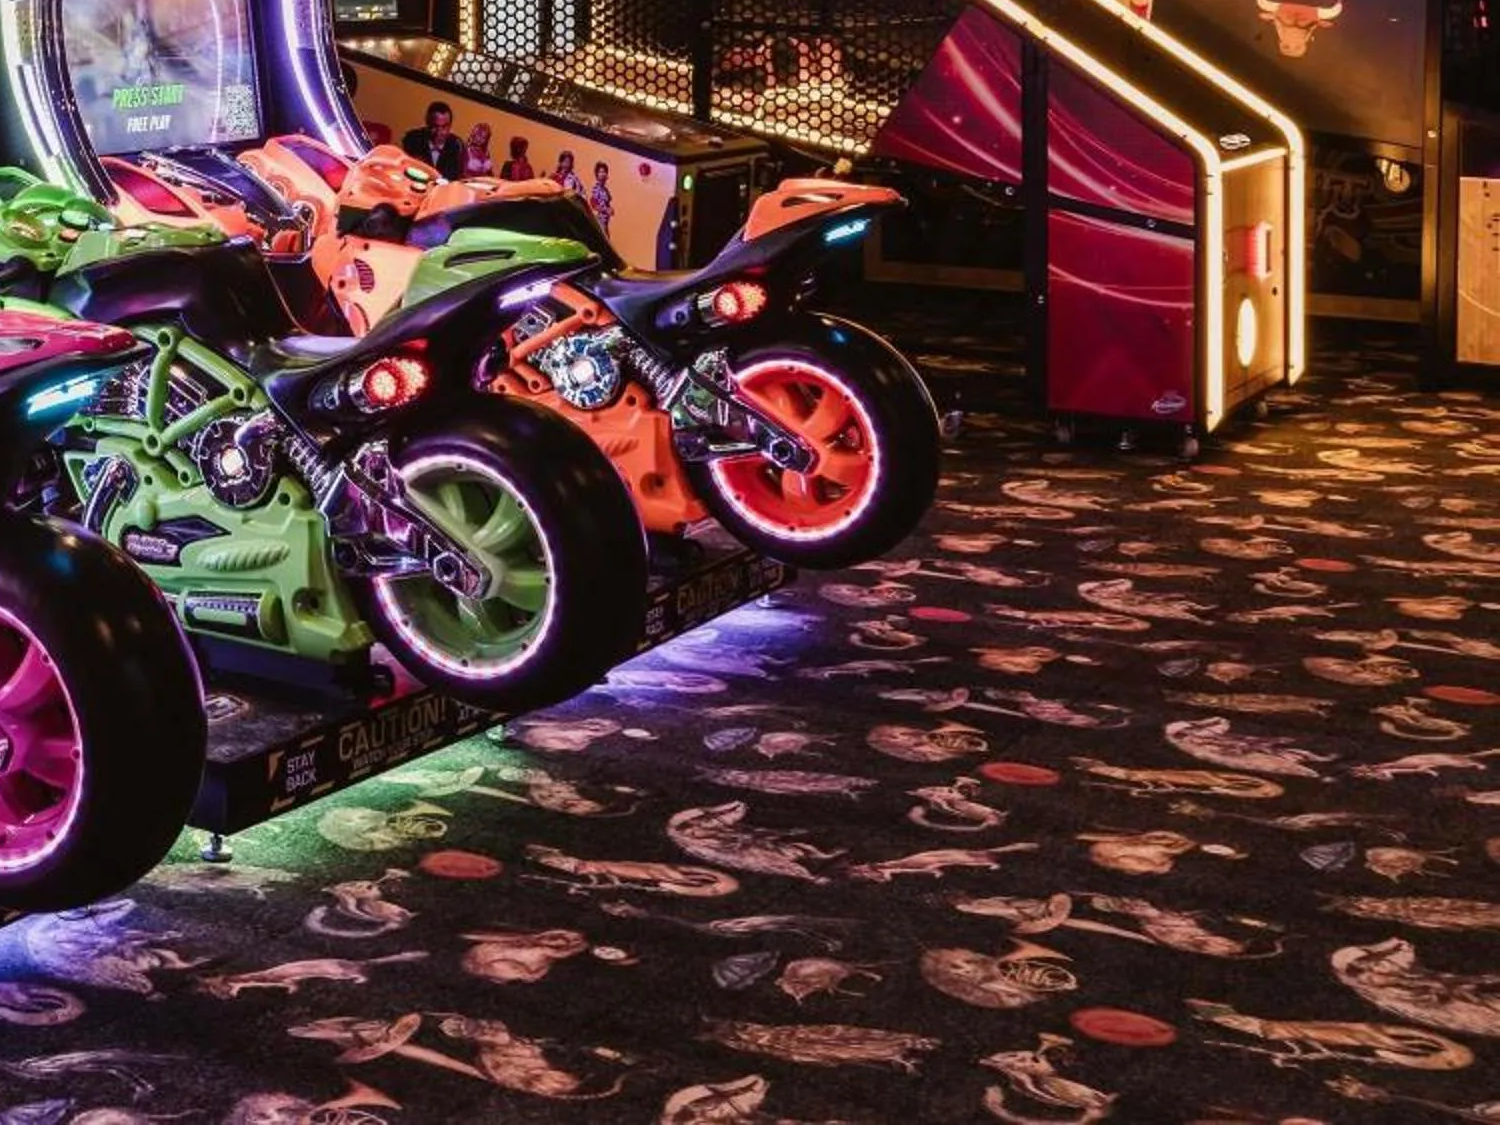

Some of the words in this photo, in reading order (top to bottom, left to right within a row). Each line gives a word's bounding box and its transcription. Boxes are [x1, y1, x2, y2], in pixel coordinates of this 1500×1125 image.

[112, 86, 150, 109] PRESS
[151, 84, 184, 106] START
[150, 114, 172, 131] PLAY
[339, 697, 447, 762] CAUTION!
[286, 749, 316, 774] STAY
[285, 770, 317, 793] BACK
